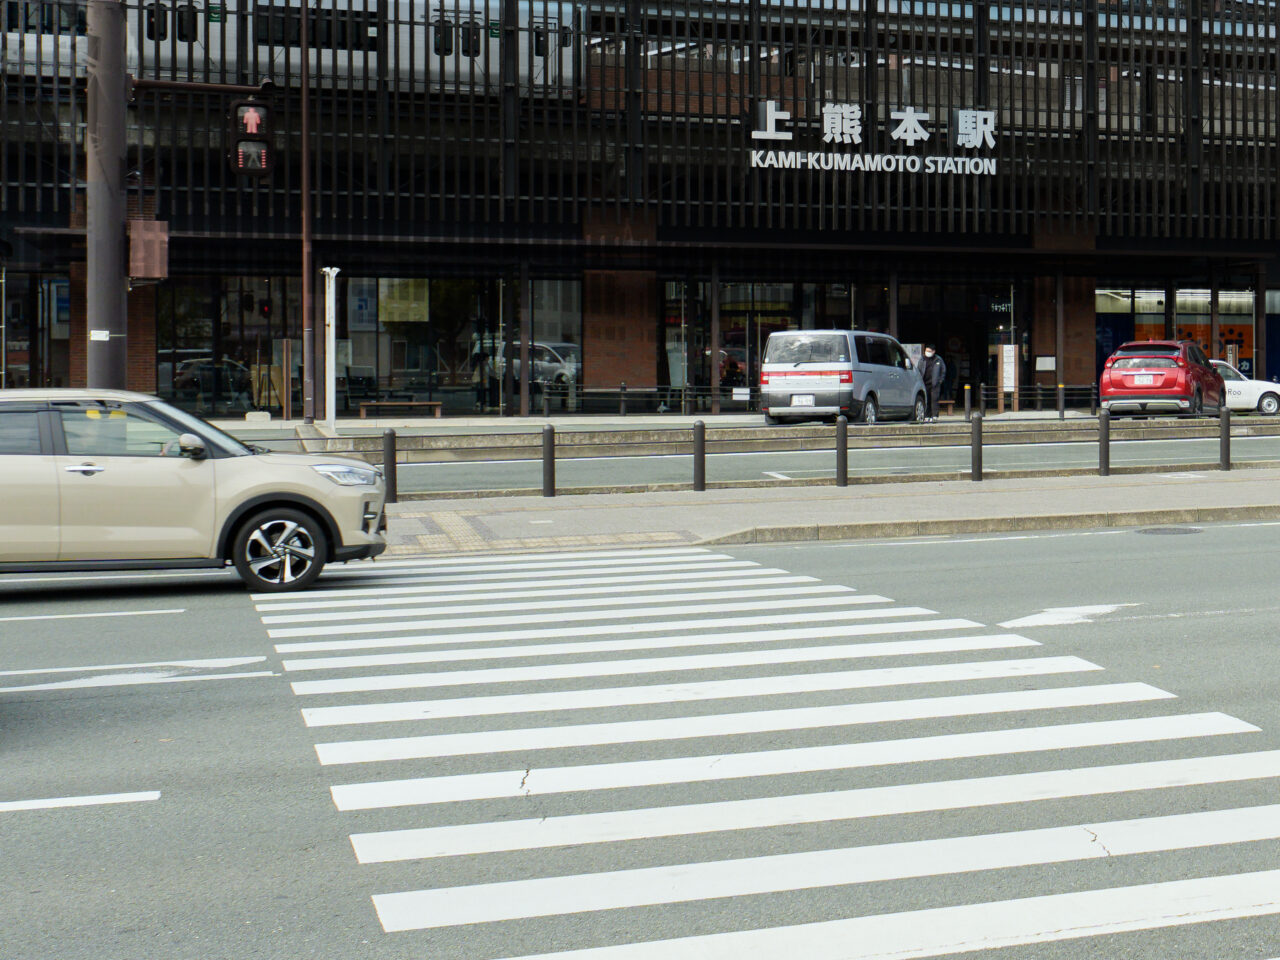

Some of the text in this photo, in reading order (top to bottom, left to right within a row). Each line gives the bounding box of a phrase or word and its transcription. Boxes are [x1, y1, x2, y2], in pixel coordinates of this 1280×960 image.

[751, 100, 996, 149] 上熊本駅
[751, 150, 997, 175] KAMI-KUMAMOTO STATION
